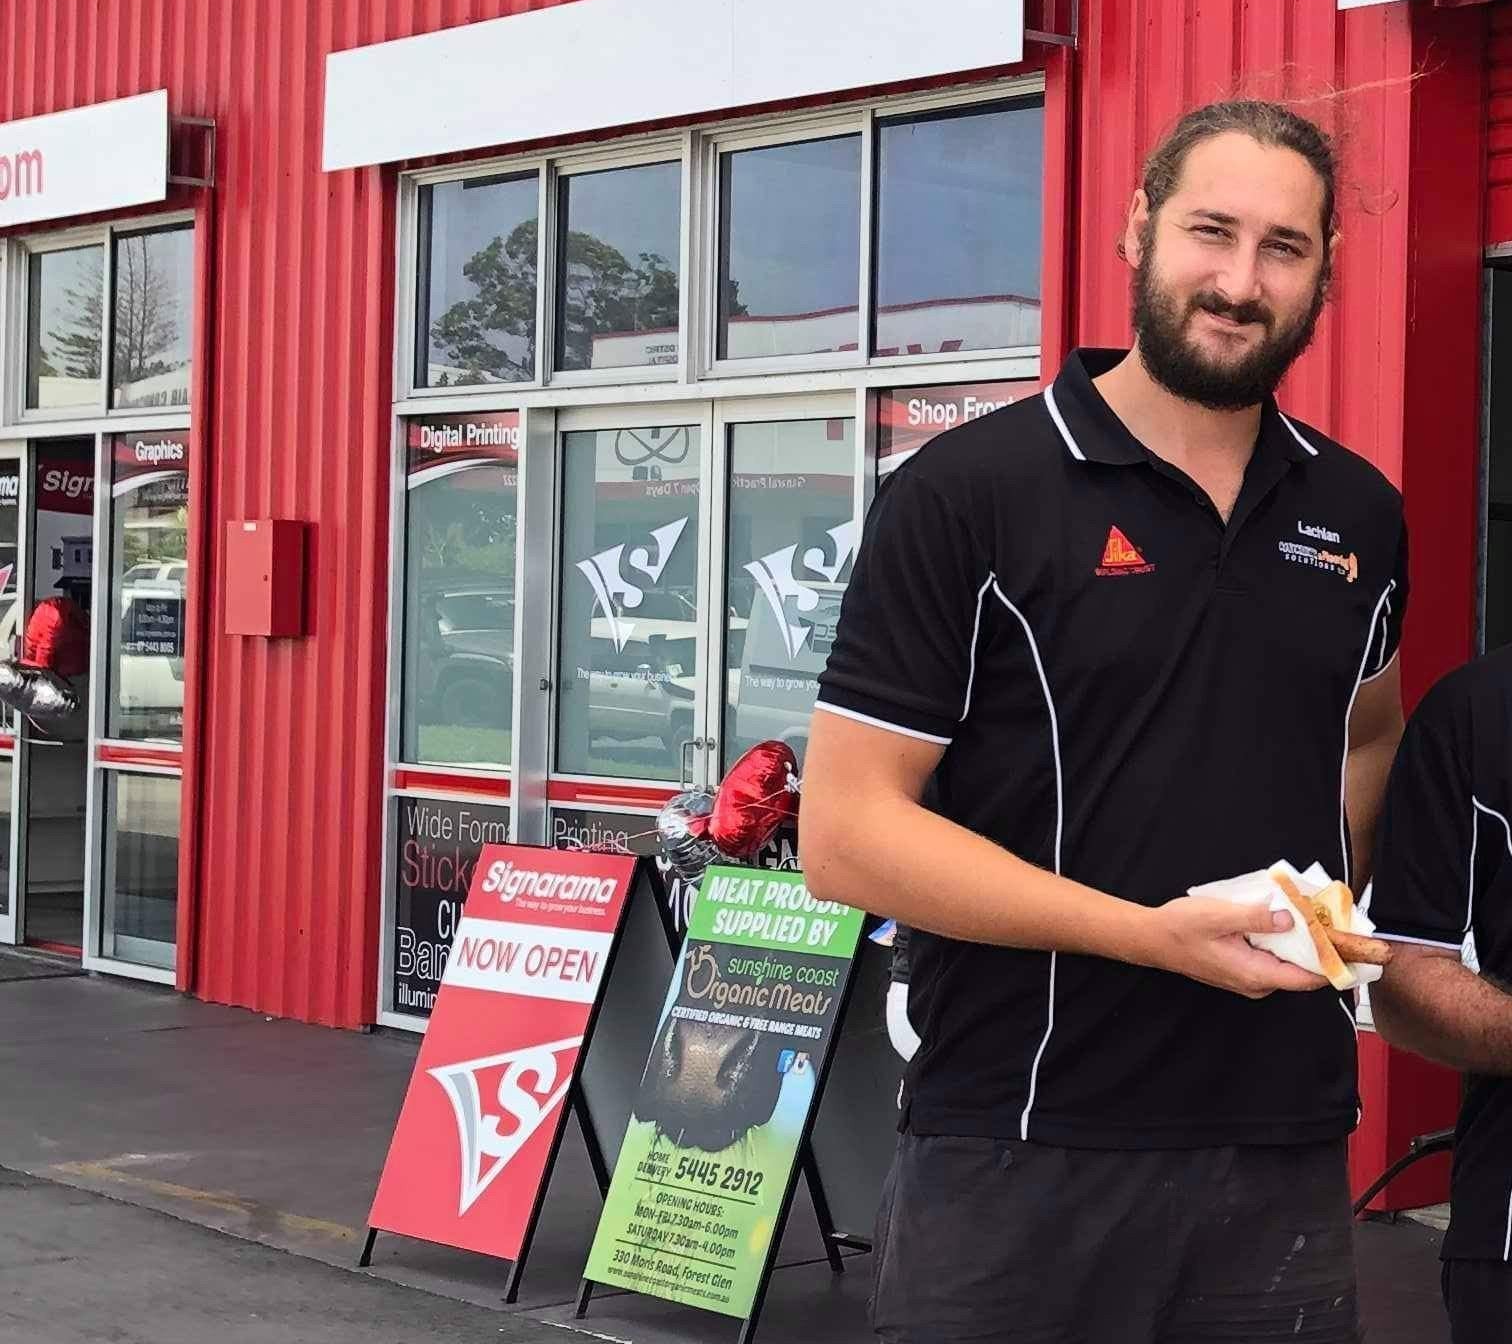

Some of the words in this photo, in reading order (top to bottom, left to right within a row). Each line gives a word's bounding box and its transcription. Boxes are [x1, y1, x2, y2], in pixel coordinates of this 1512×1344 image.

[908, 398, 957, 430] Shop
[135, 440, 184, 465] Graphics
[421, 424, 463, 453] Digital
[466, 422, 519, 449] Printing
[1298, 520, 1340, 543] Lachlan
[407, 806, 453, 839] Wide
[554, 817, 628, 854] Printing
[482, 859, 618, 904] Signarama
[706, 876, 764, 906] MEAT
[712, 908, 805, 944] SUPPLIED
[807, 918, 838, 947] BY
[457, 937, 521, 972] NOW
[525, 944, 599, 983] OPEN
[728, 957, 793, 985] sunshine
[796, 966, 840, 987] coast
[688, 953, 769, 1009] Organic
[769, 983, 832, 1016] Meats
[671, 1005, 708, 1020] CERTIFIED
[708, 1010, 743, 1027] ORGANIC
[750, 1017, 769, 1032] FREE
[768, 1020, 795, 1035] RANGE
[793, 1024, 823, 1039] MEATS
[647, 1151, 670, 1163] HOME
[675, 1156, 720, 1186] 5445
[720, 1166, 764, 1195] 2912
[656, 1192, 692, 1210] OPENING
[626, 1222, 669, 1242] SATURDAY
[612, 1248, 631, 1264] 330
[682, 1266, 712, 1284] Forest
[711, 1275, 733, 1290] Glen
